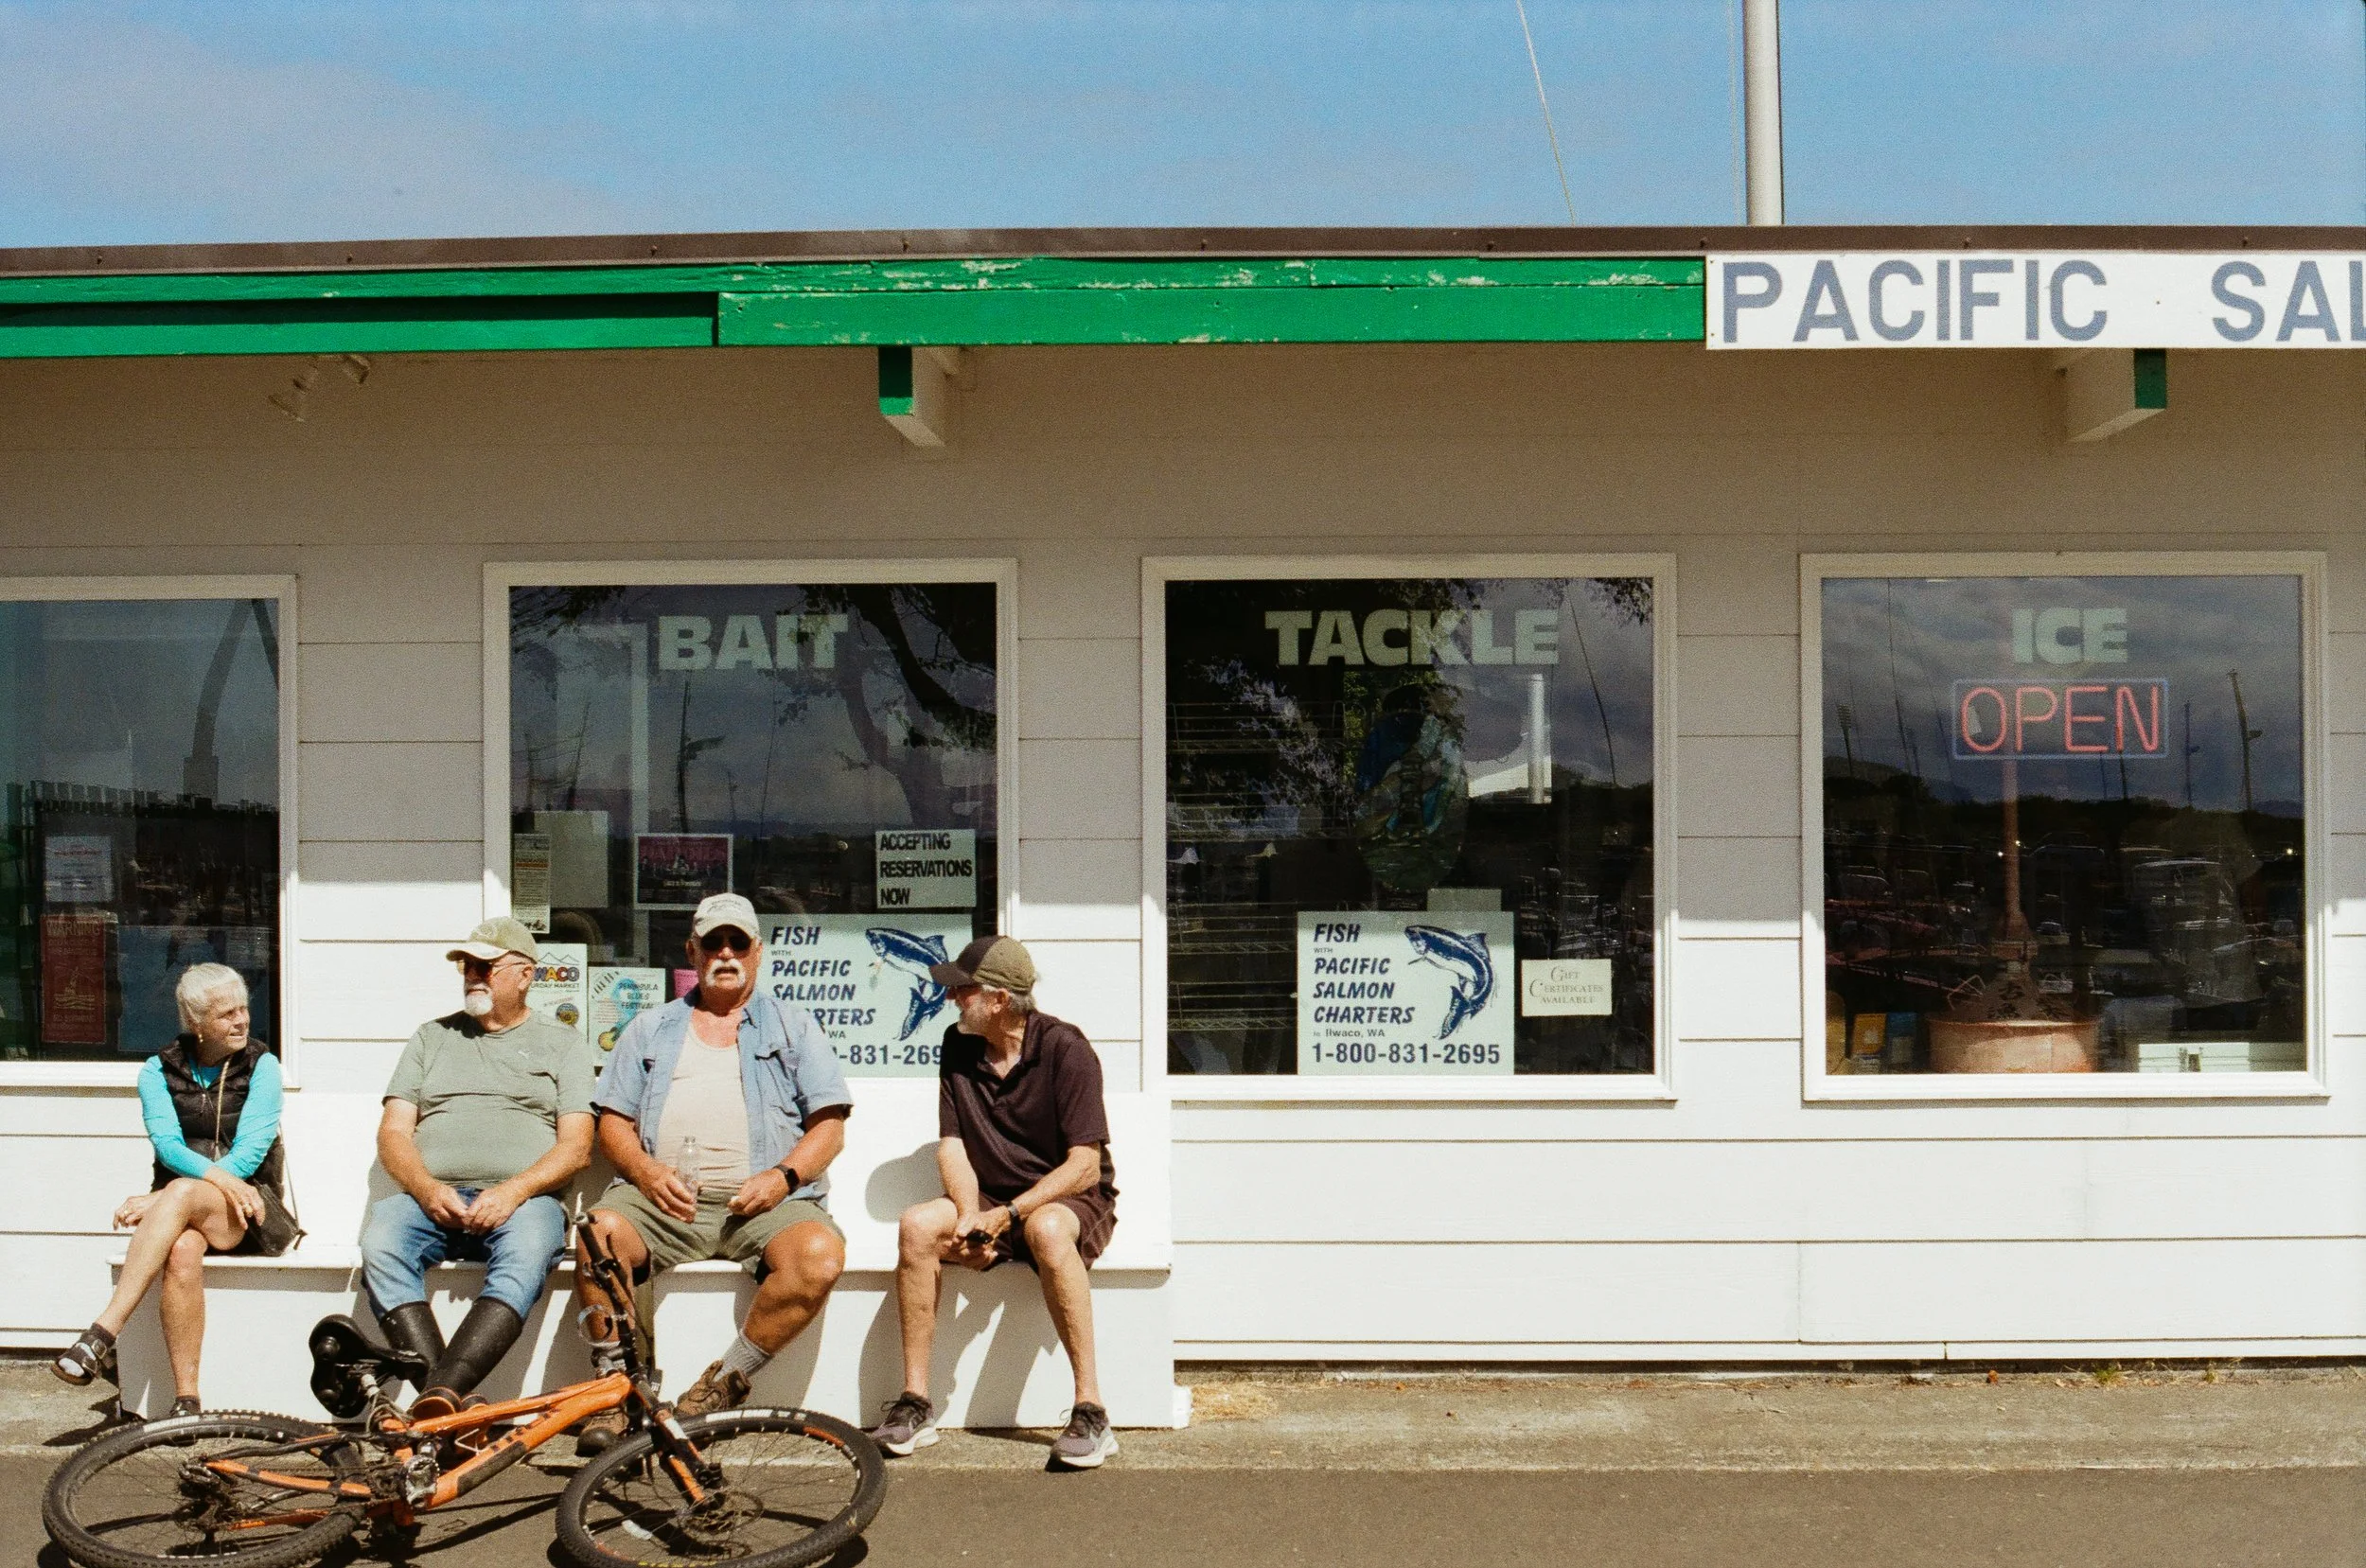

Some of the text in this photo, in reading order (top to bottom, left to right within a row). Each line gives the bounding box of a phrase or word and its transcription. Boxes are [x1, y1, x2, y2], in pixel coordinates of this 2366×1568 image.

[1722, 259, 2366, 343] PACIFIC SAL
[659, 614, 848, 670] BAIT
[1265, 609, 1561, 666] TACKLE
[2011, 608, 2128, 664] ICE
[1960, 686, 2158, 752] OPEN
[880, 833, 951, 850] ACCEPTING
[880, 859, 973, 878] RESERVATIONS
[880, 888, 910, 905] NOW
[770, 926, 821, 945] FISH
[1314, 924, 1361, 943] FISH
[533, 967, 580, 981] WACO
[772, 960, 852, 977] PACIFIC
[1315, 958, 1390, 974] PACIFIC
[773, 984, 856, 1000] SALMON
[1313, 982, 1395, 998] SALMON
[812, 1009, 875, 1026] RTERS
[1314, 1006, 1415, 1024] CHARTERS
[1368, 1029, 1385, 1037] WA
[833, 1045, 942, 1065] -831-269
[1312, 1043, 1500, 1064] 1-800-831-2695
